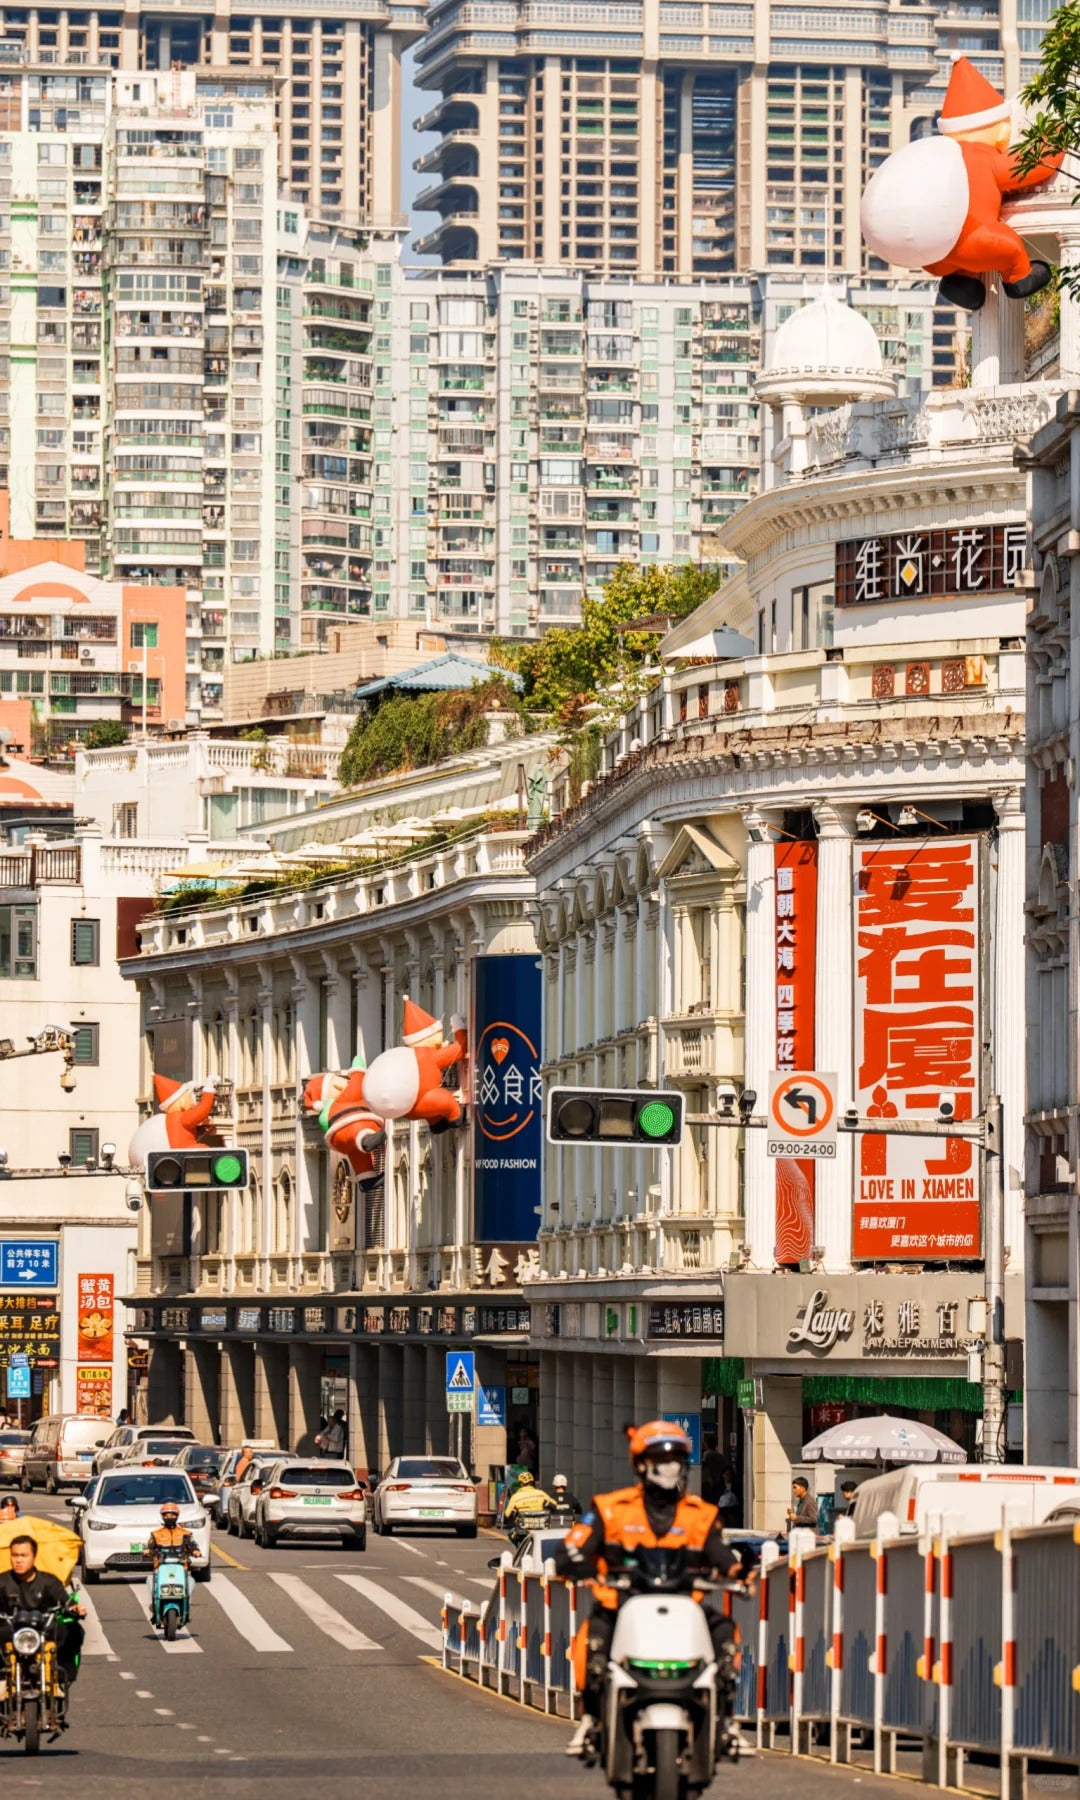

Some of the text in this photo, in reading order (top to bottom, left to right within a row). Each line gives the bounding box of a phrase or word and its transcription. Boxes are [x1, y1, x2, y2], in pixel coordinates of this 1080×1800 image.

[776, 867, 796, 970] 面朝大海
[858, 843, 975, 1176] 爱在厦门
[482, 1159, 499, 1169] FOOD
[500, 1159, 537, 1169] FASHION
[860, 1177, 975, 1200] LOVE IN XIAMEN
[860, 1217, 906, 1229] 我喜欢厦门
[890, 1234, 974, 1247] 更喜欢这个城市的你
[7, 1249, 50, 1258] 公共停车场
[29, 1260, 39, 1268] 10
[80, 1278, 111, 1294] 蟹黄
[80, 1296, 111, 1309] 汤包
[29, 1315, 59, 1331] 足疗
